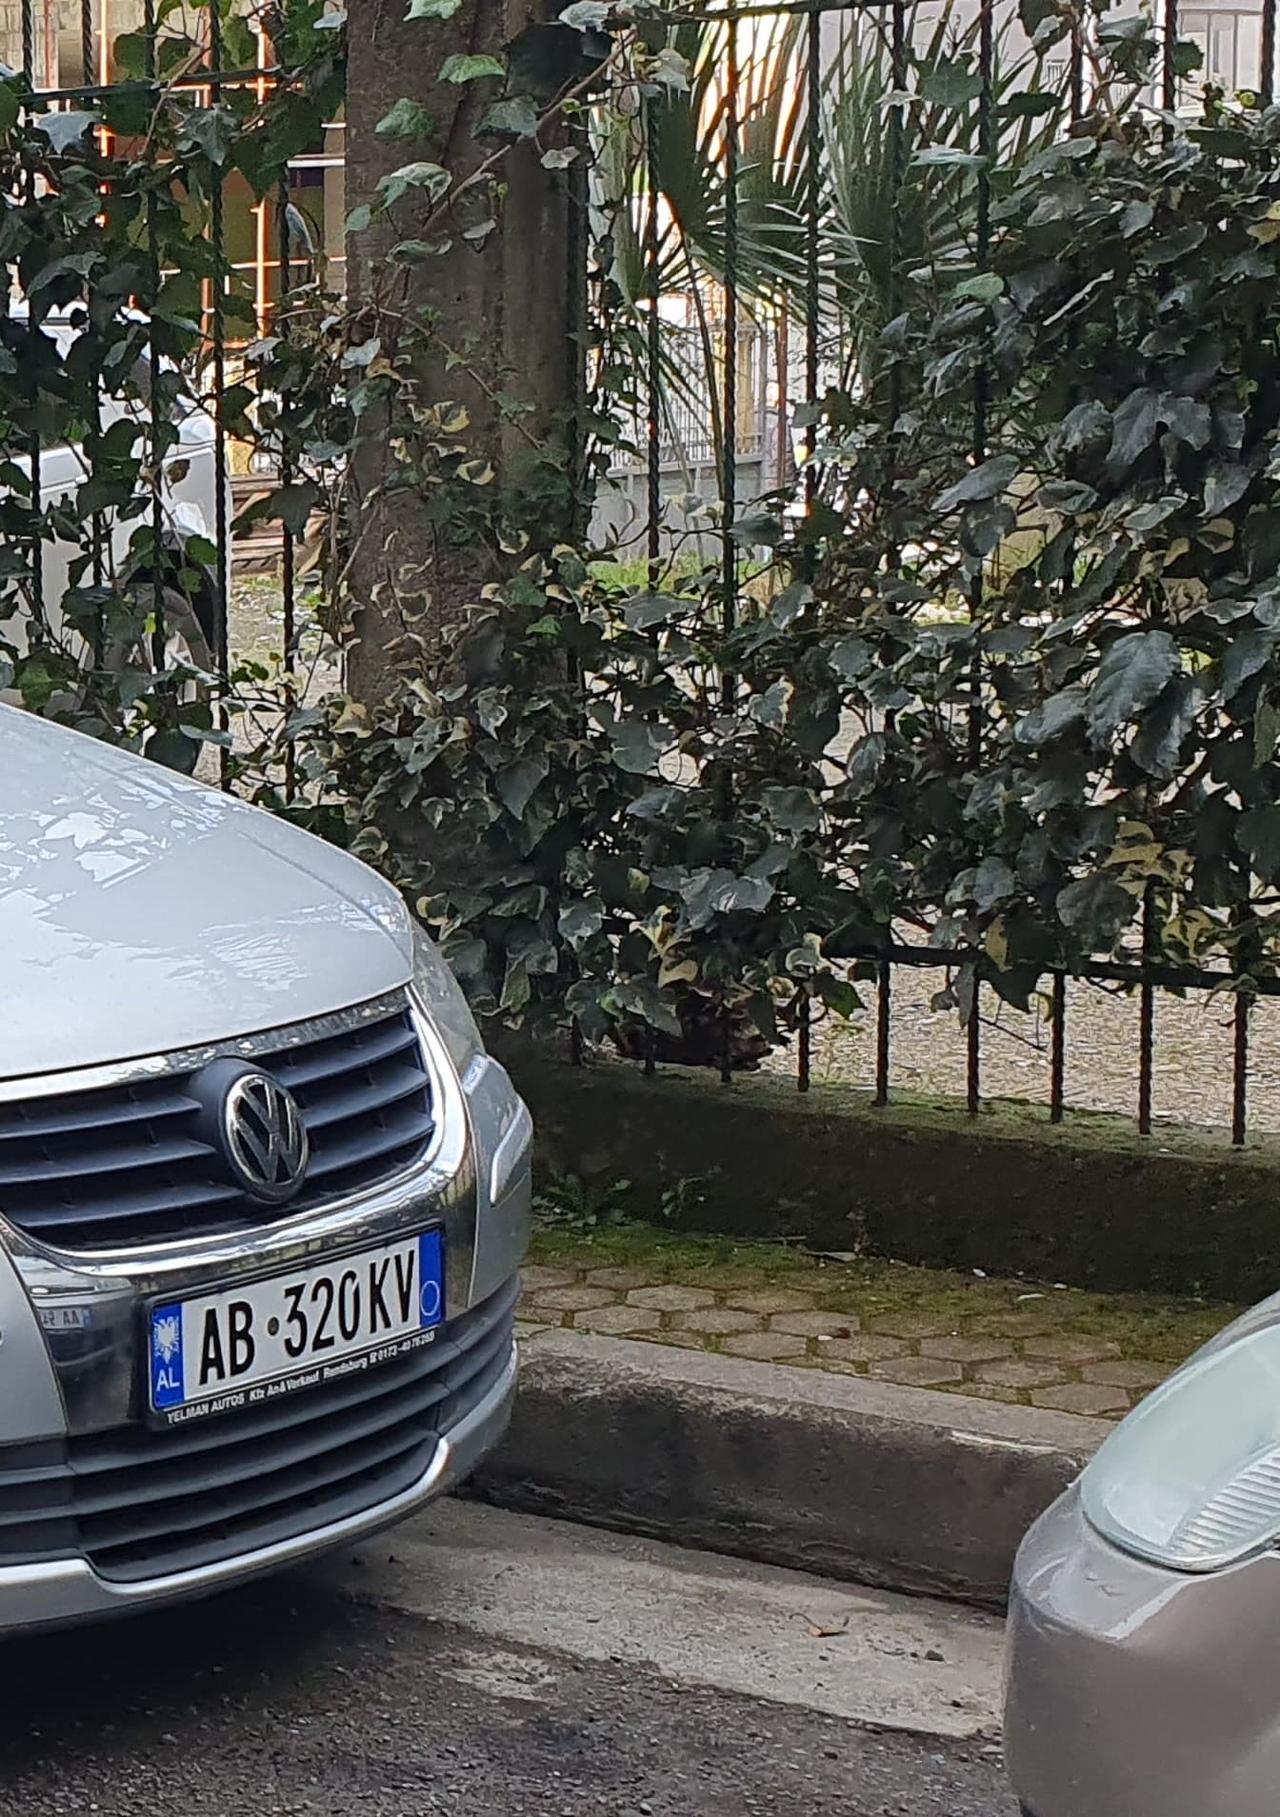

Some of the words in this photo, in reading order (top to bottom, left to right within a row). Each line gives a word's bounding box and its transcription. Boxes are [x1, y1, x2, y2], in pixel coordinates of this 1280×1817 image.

[198, 1301, 255, 1385] AB
[284, 1270, 360, 1358] 320
[369, 1249, 415, 1334] KV
[156, 1367, 180, 1391] AL
[167, 1403, 209, 1424] YELMAN
[211, 1393, 244, 1412] AUTOS
